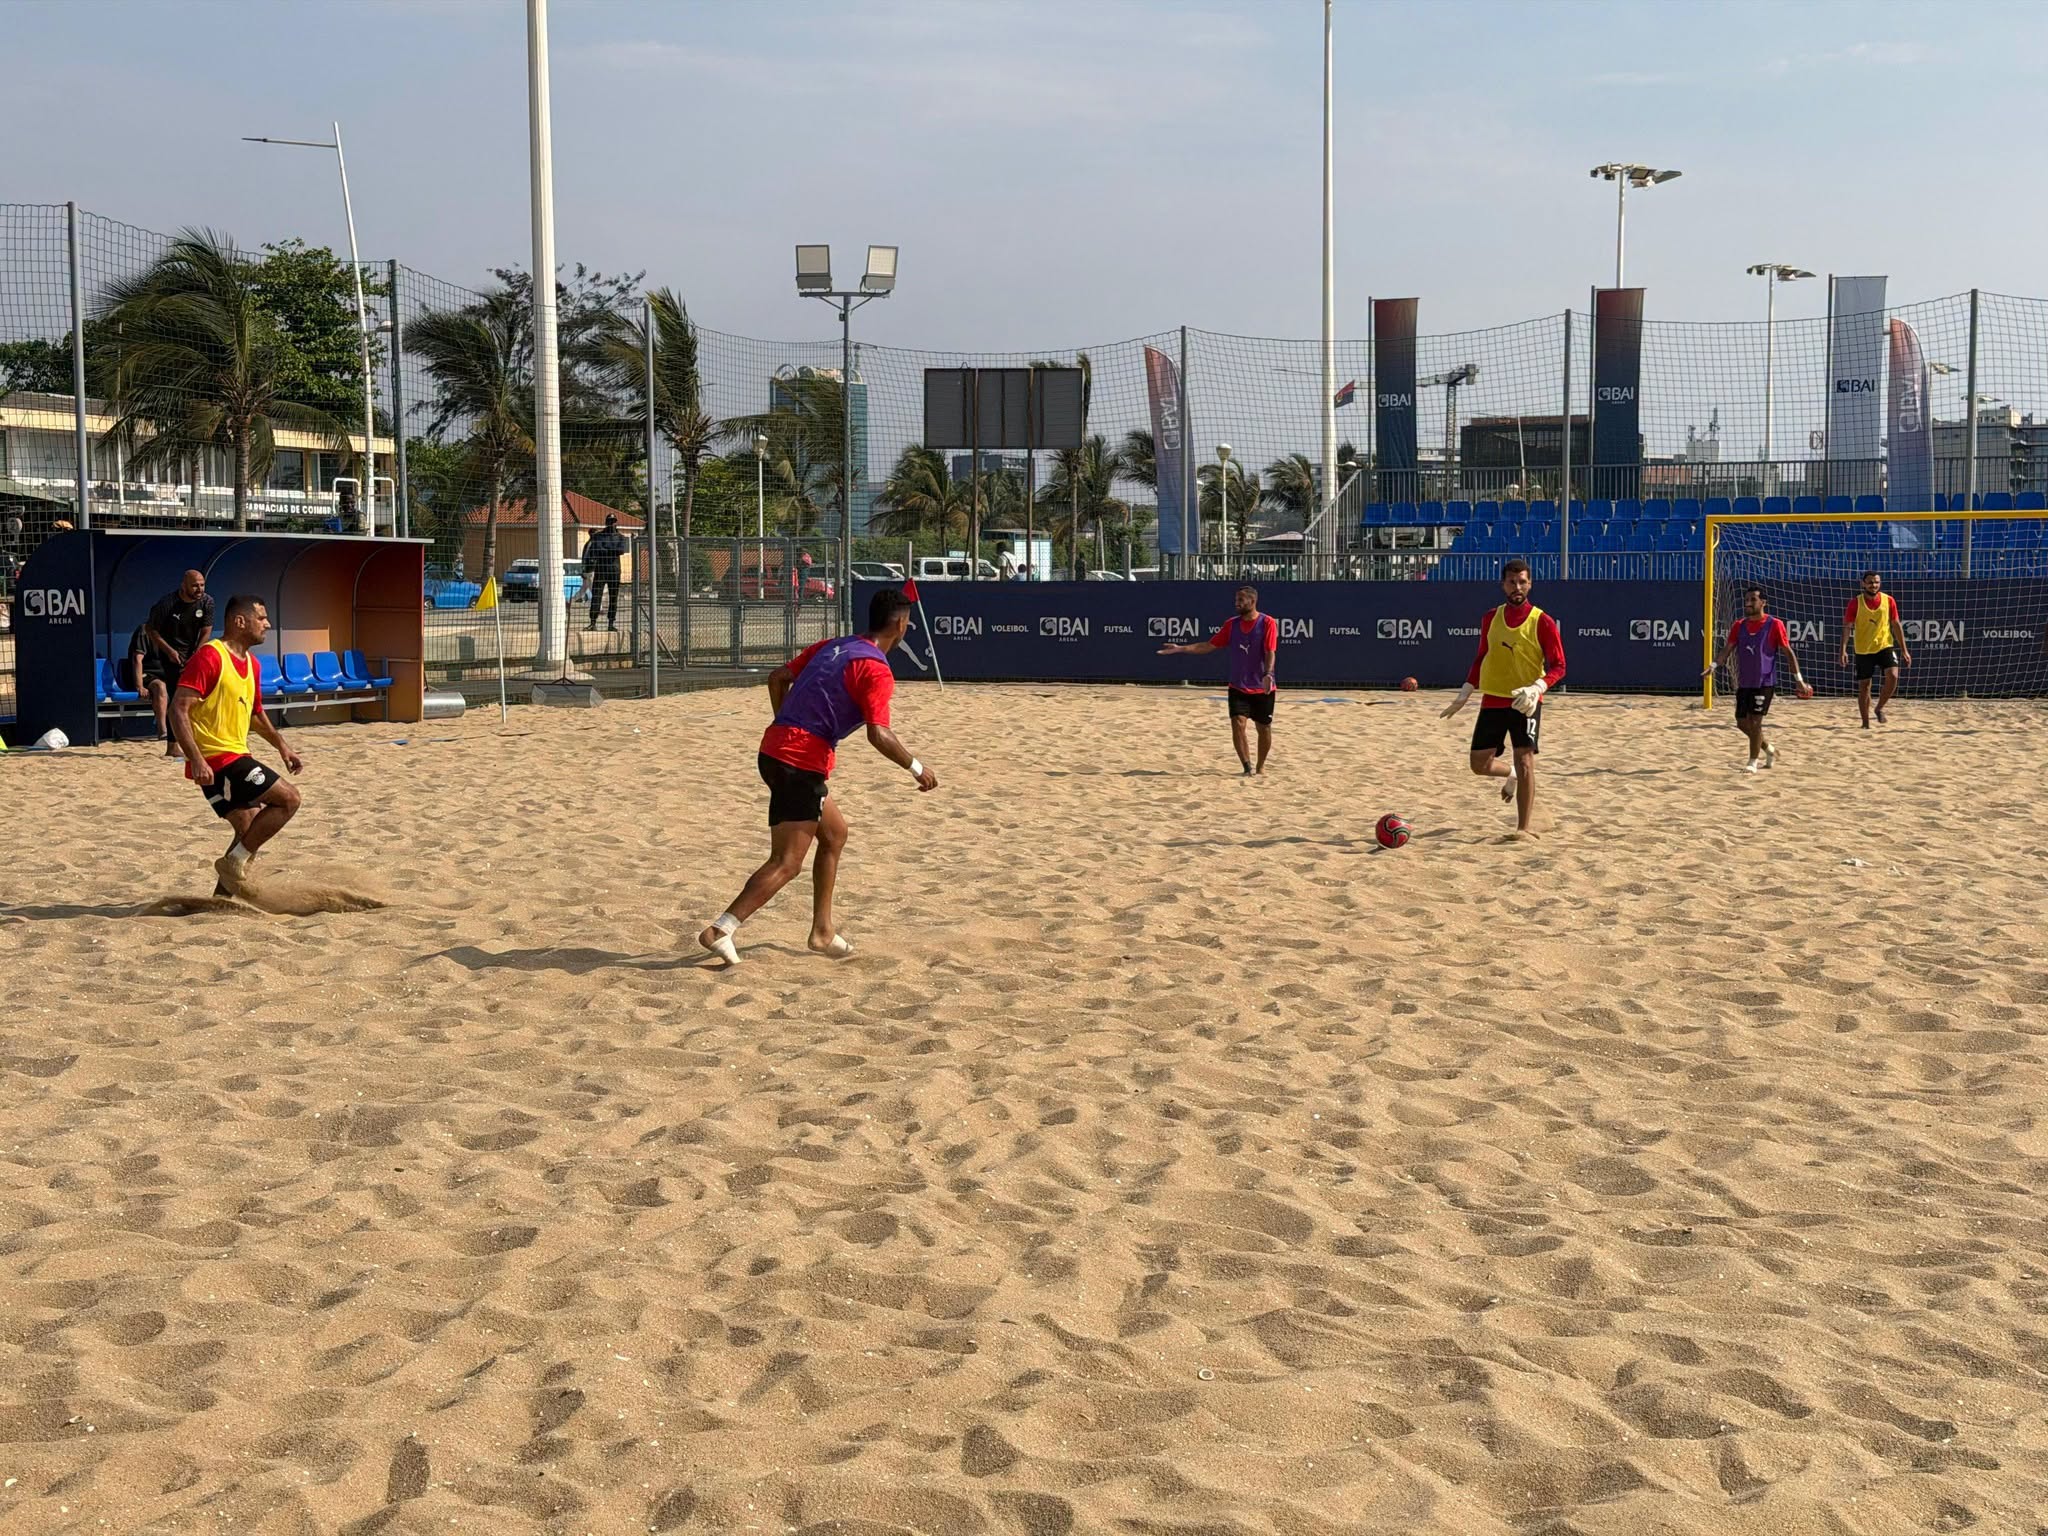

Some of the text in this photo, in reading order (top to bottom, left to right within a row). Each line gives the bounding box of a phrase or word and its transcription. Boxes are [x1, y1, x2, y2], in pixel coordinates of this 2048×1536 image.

[1851, 379, 1874, 392] BAI
[1390, 393, 1411, 407] BAI
[1612, 386, 1634, 400] BAI
[290, 504, 300, 514] DE
[302, 505, 336, 515] COIMBR
[47, 588, 85, 615] BAI
[953, 616, 983, 635] BAI
[991, 624, 1029, 633] VOLEIBOL
[1058, 617, 1089, 636] BAI
[1103, 625, 1133, 633] FUTSAL
[1168, 617, 1199, 637] BAI
[1281, 618, 1313, 638] BAI
[1329, 627, 1361, 635] FUTSAL
[1399, 619, 1432, 639] BAI
[1447, 627, 1482, 636] VOLEIB
[1578, 628, 1612, 637] FUTSAL
[1653, 619, 1689, 641] BAI
[1786, 620, 1824, 642] BAI
[1925, 620, 1965, 642] BAI
[1983, 629, 2035, 639] VOLEIBOL
[1526, 718, 1537, 735] 12
